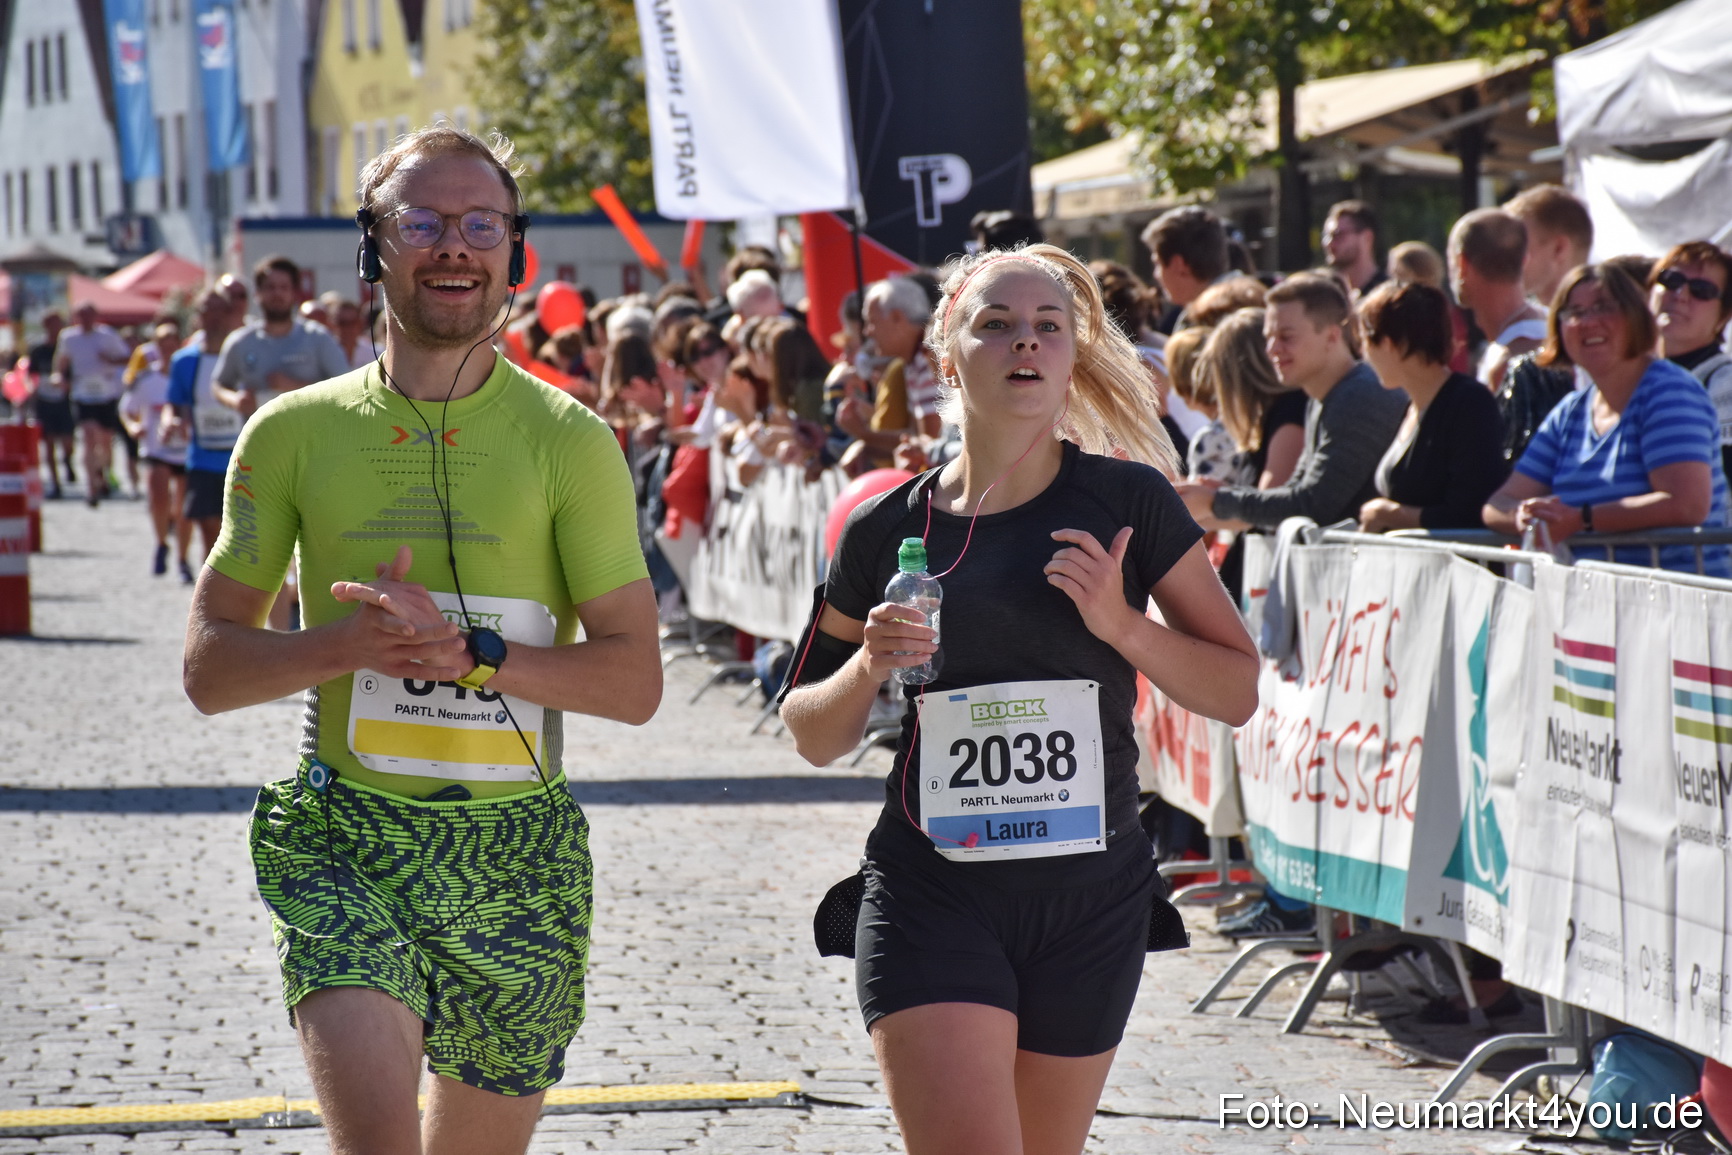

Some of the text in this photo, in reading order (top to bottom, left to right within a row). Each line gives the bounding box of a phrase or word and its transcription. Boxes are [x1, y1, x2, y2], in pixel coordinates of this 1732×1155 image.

[441, 609, 503, 633] OCK
[394, 703, 492, 722] PARTL Neumarkt
[970, 698, 1048, 721] BOCK
[972, 717, 1050, 728] inspired by smart concepts
[949, 730, 1078, 789] 2038
[961, 792, 1055, 808] PARTL Neumarkt
[985, 819, 1048, 841] Laura
